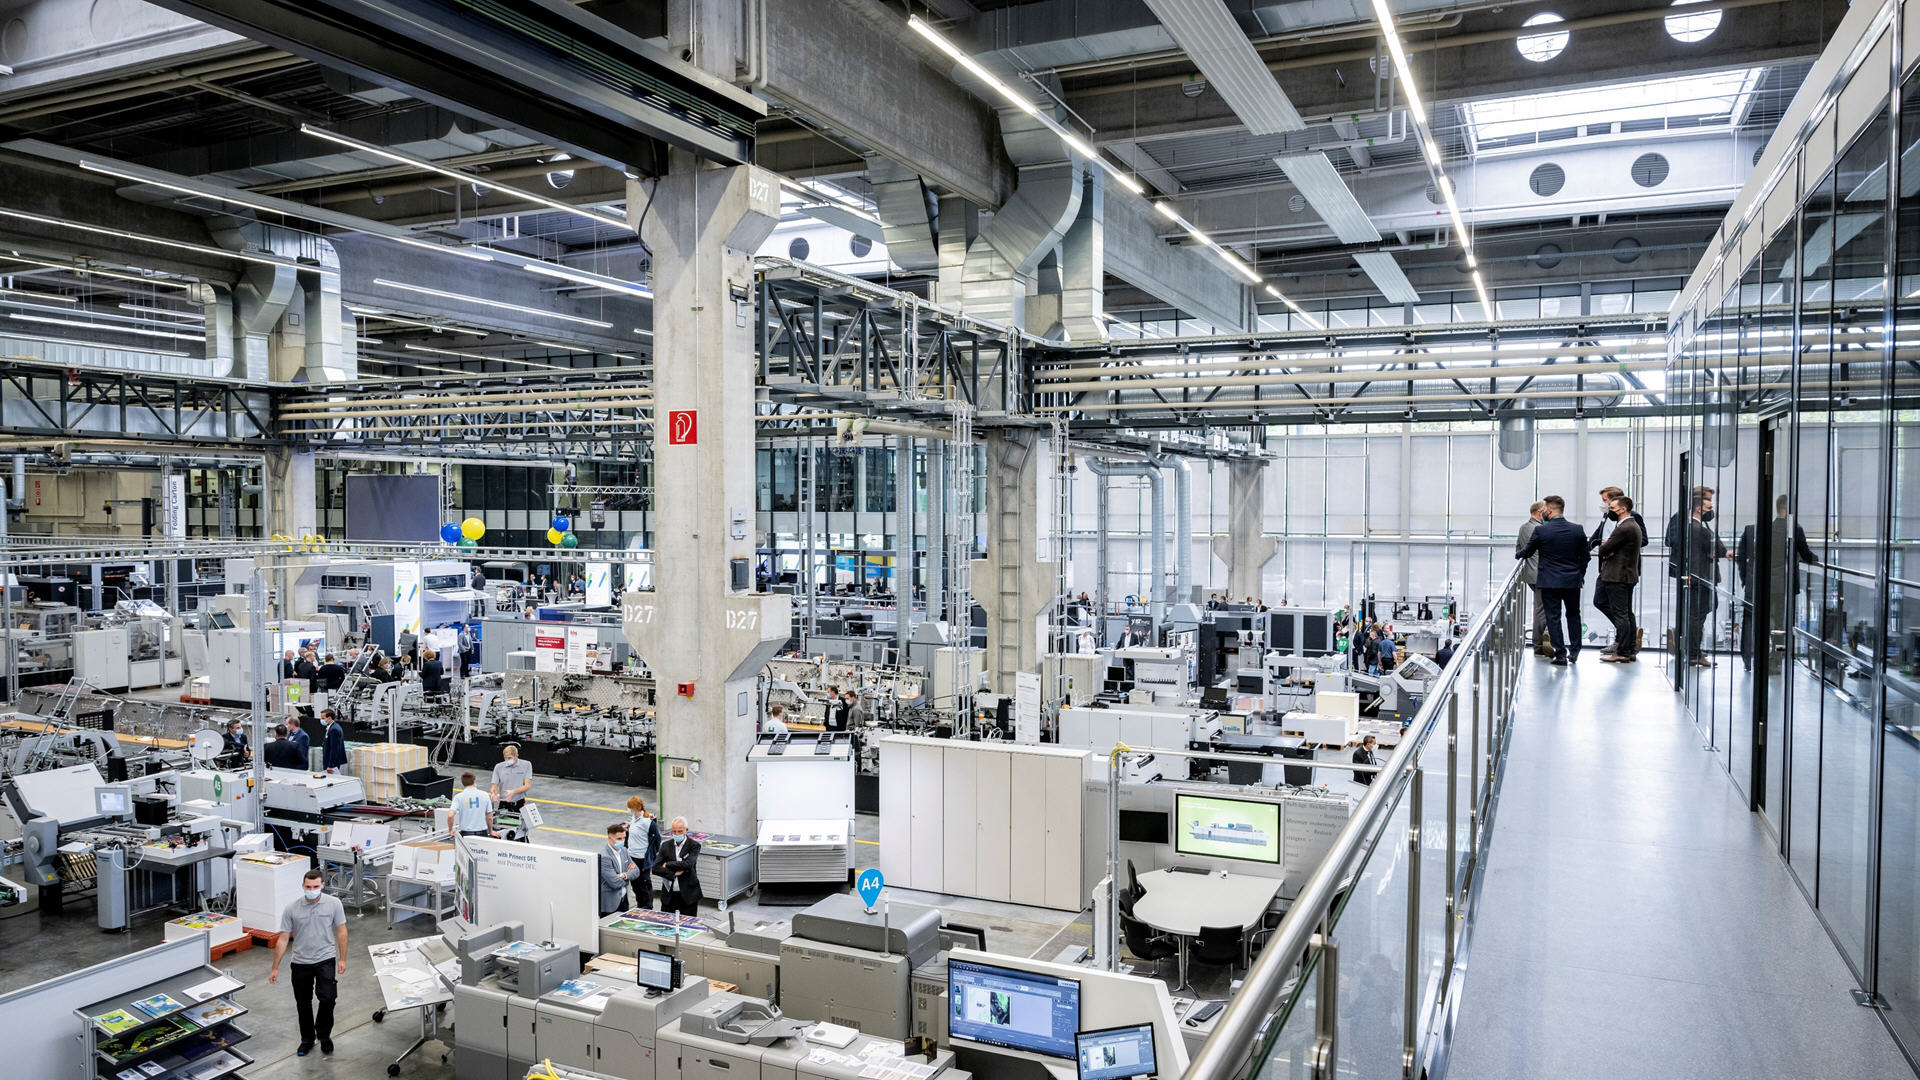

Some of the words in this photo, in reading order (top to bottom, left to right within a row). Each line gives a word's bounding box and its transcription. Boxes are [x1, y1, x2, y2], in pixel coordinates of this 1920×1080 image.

[749, 177, 769, 202] D27
[623, 604, 654, 624] D27
[726, 609, 758, 630] D27
[508, 852, 527, 861] Prinect
[861, 876, 880, 891] A4
